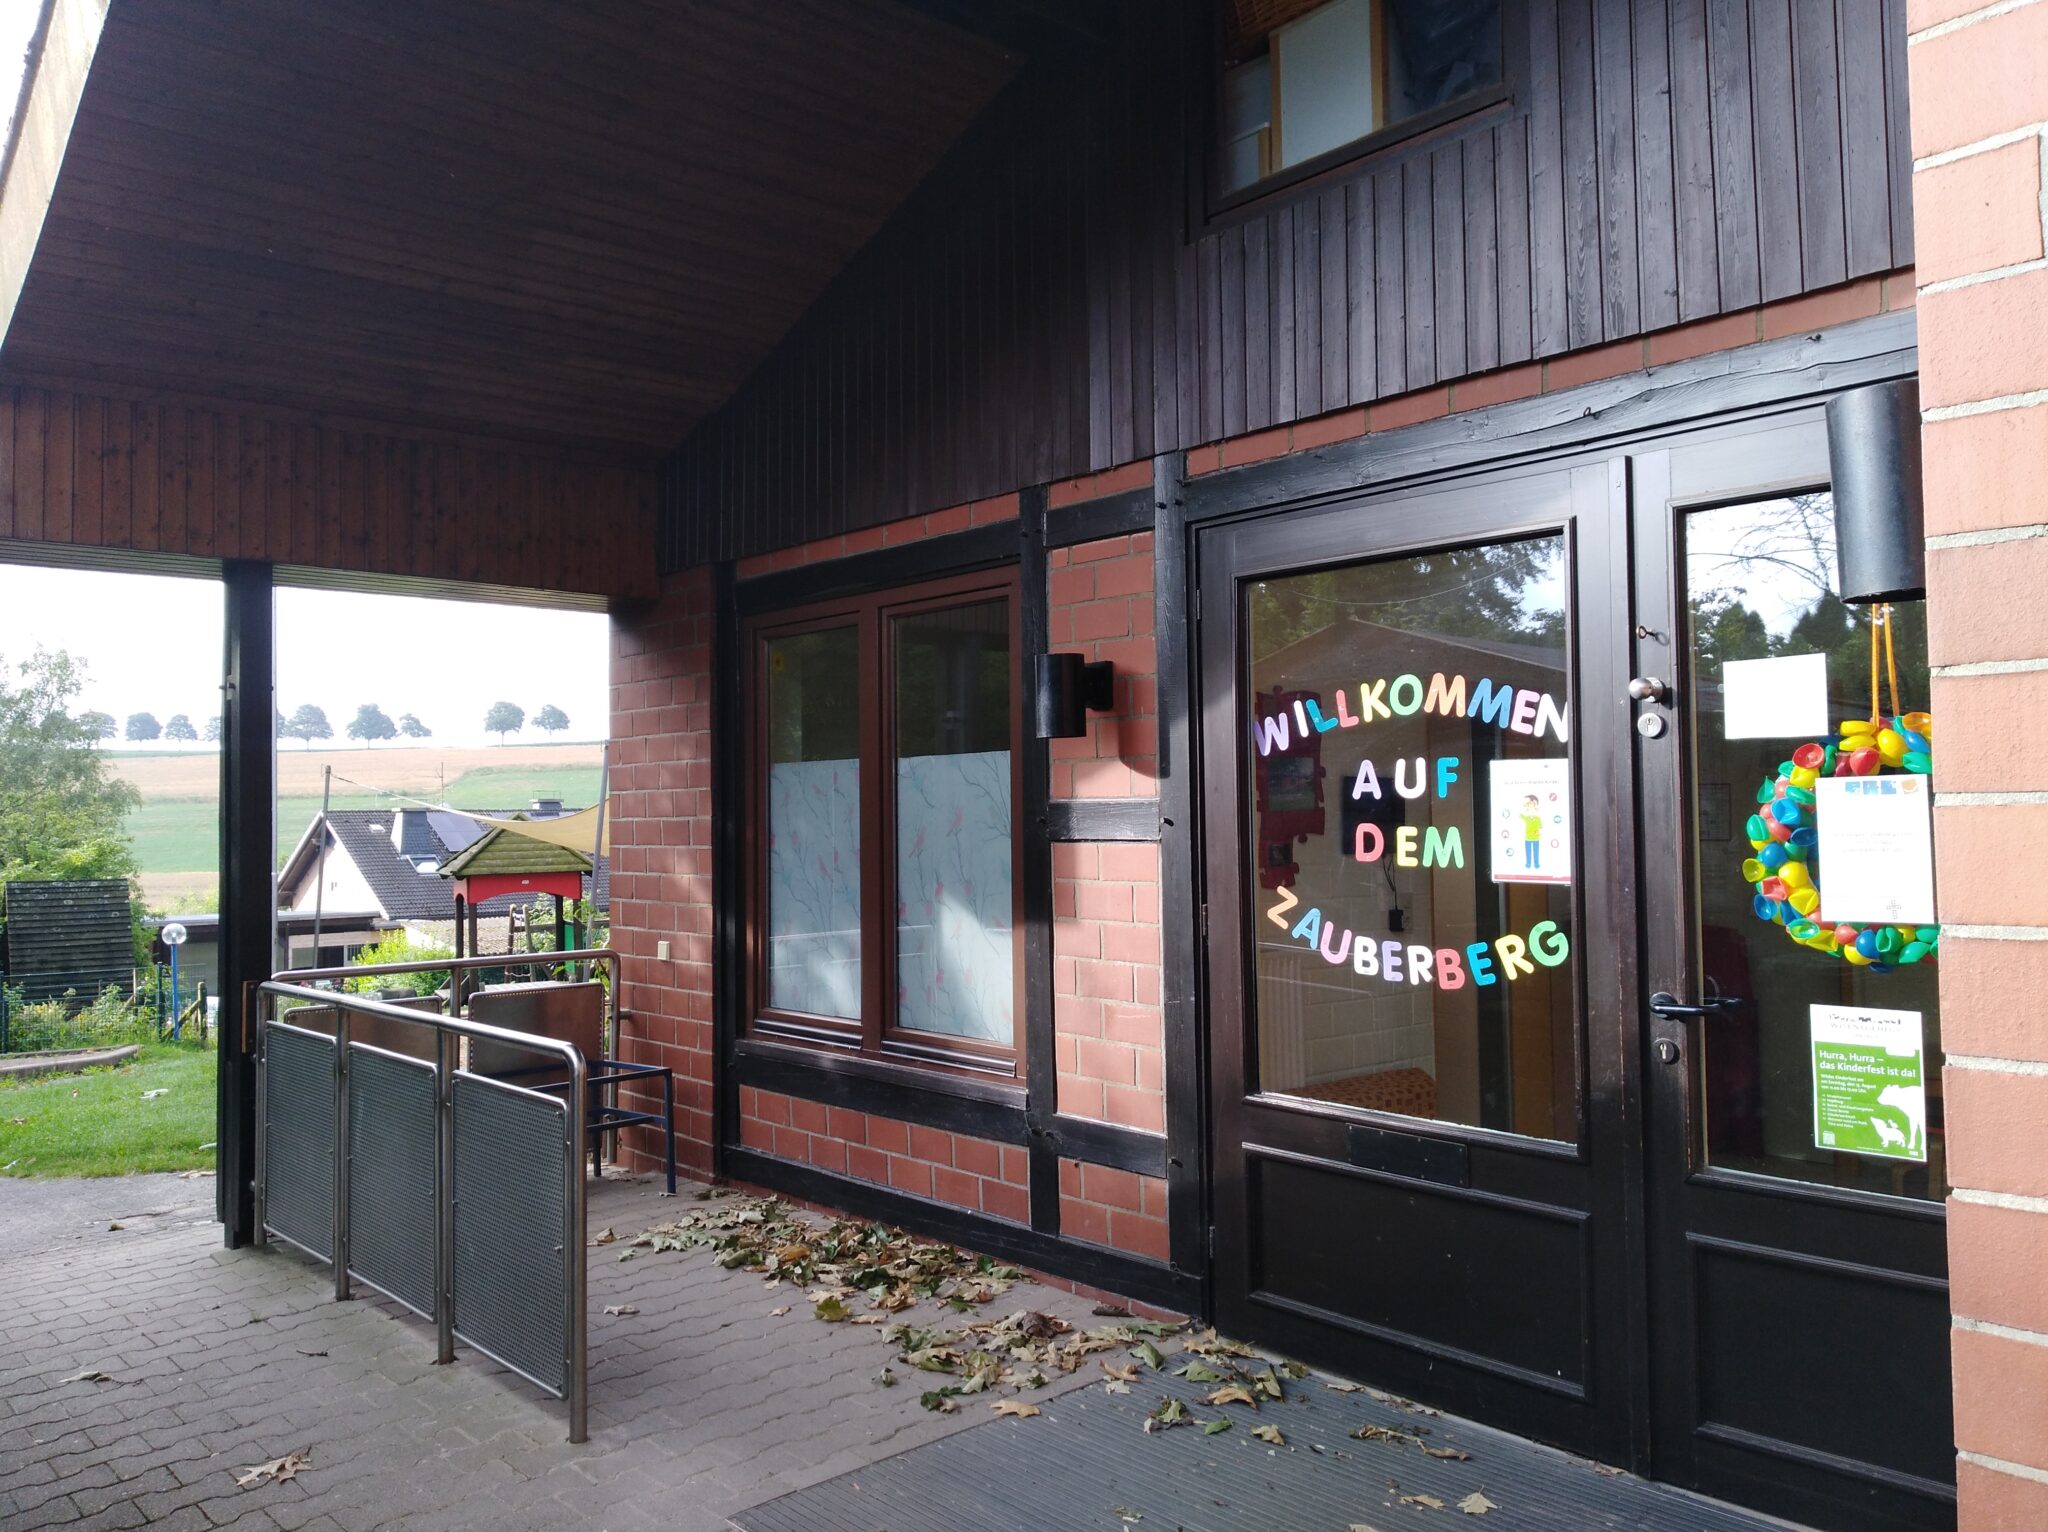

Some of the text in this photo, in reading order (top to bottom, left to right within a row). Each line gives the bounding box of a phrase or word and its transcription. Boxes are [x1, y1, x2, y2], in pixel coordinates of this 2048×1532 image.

[1254, 672, 1568, 756] WILLKOMMEN
[1352, 757, 1459, 800] AUF
[1355, 822, 1465, 869] DEM
[1267, 885, 1569, 990] ZAUBERBERG
[1819, 1050, 1848, 1061] Hurra,
[1849, 1052, 1875, 1063] Hurra
[1820, 1060, 1916, 1078] das Kinderfest ist da!
